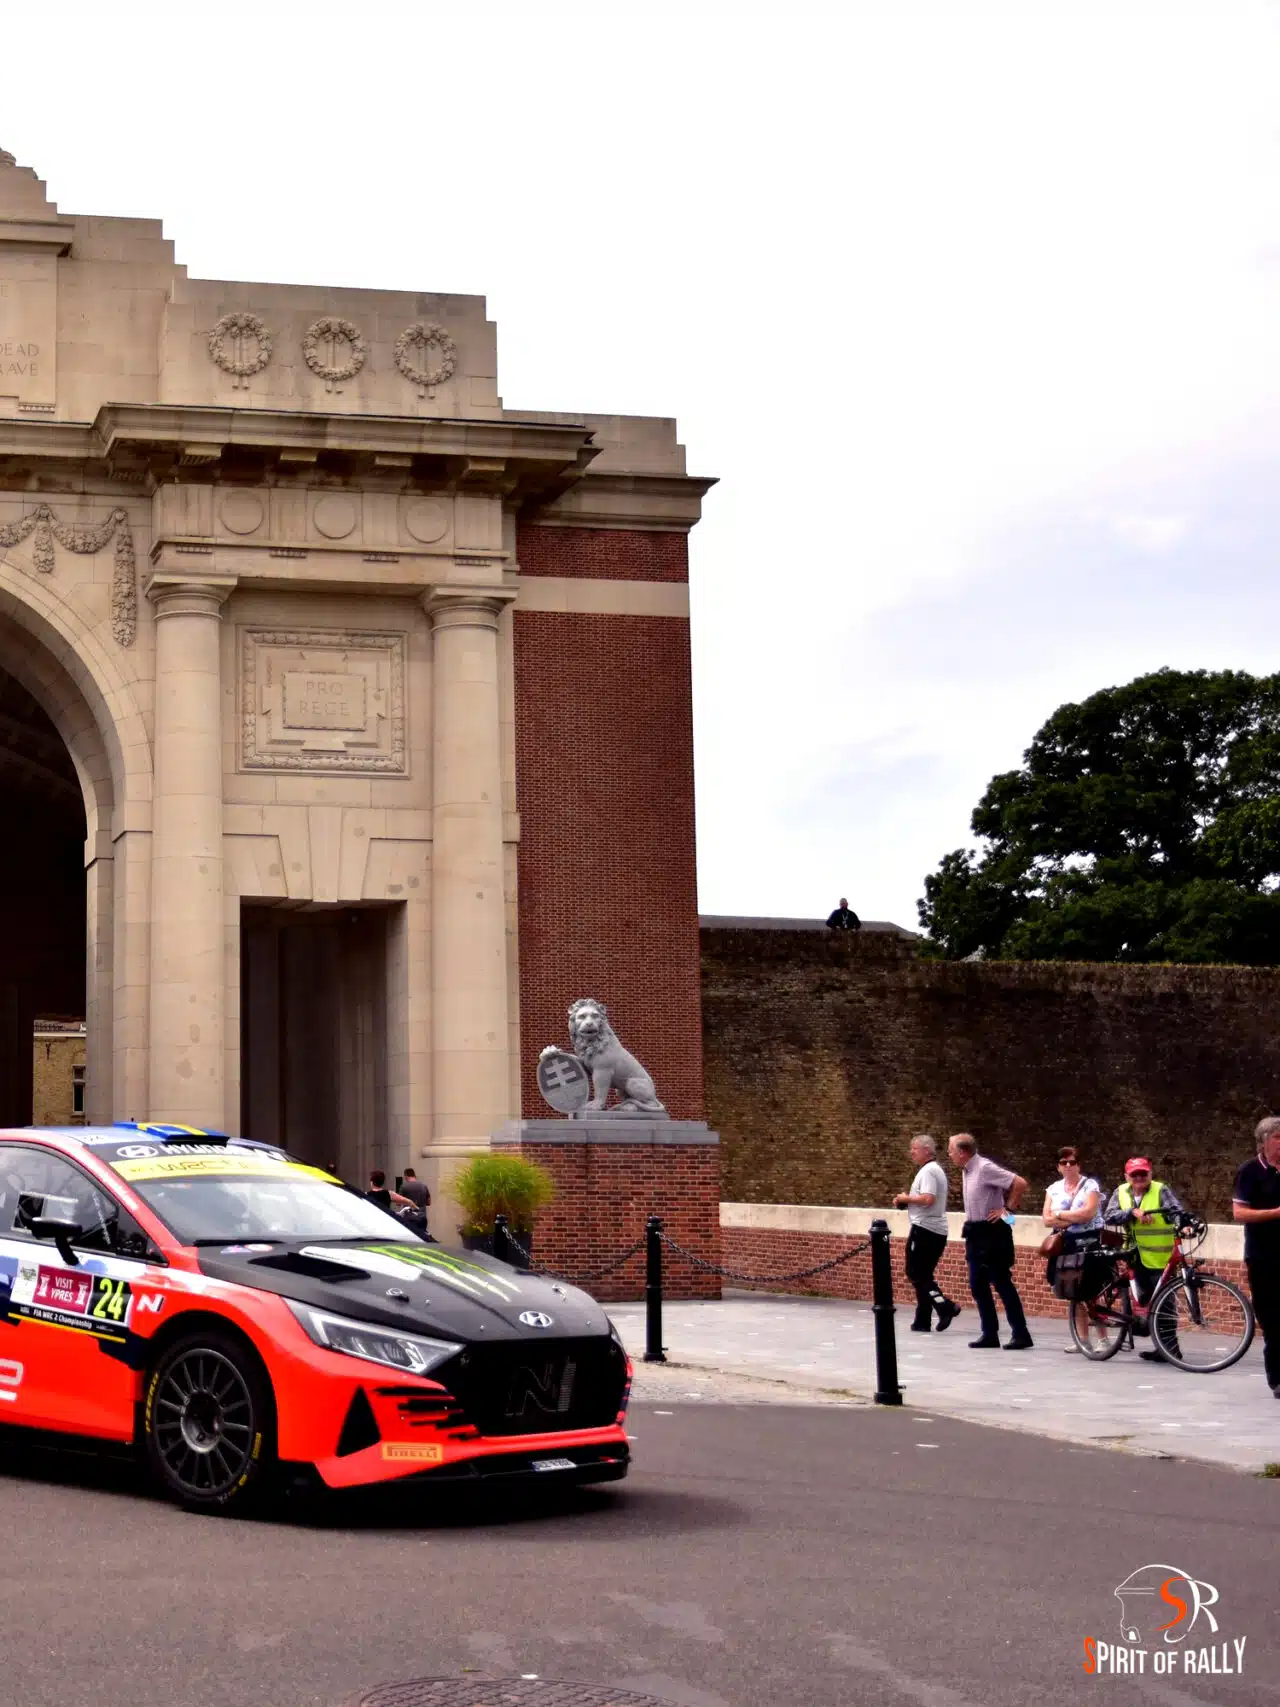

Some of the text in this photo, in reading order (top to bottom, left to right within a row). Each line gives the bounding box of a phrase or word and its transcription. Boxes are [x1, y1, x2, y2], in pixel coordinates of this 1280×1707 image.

[305, 681, 344, 695] PRO
[299, 700, 351, 716] REGE
[55, 1276, 73, 1289] VISIT
[51, 1288, 73, 1302] YPRES
[93, 1277, 124, 1320] 24
[33, 1309, 43, 1318] FIA
[43, 1310, 53, 1321] WRC
[54, 1313, 59, 1321] 2
[58, 1315, 93, 1330] Championship
[387, 1446, 437, 1458] PIRELLI
